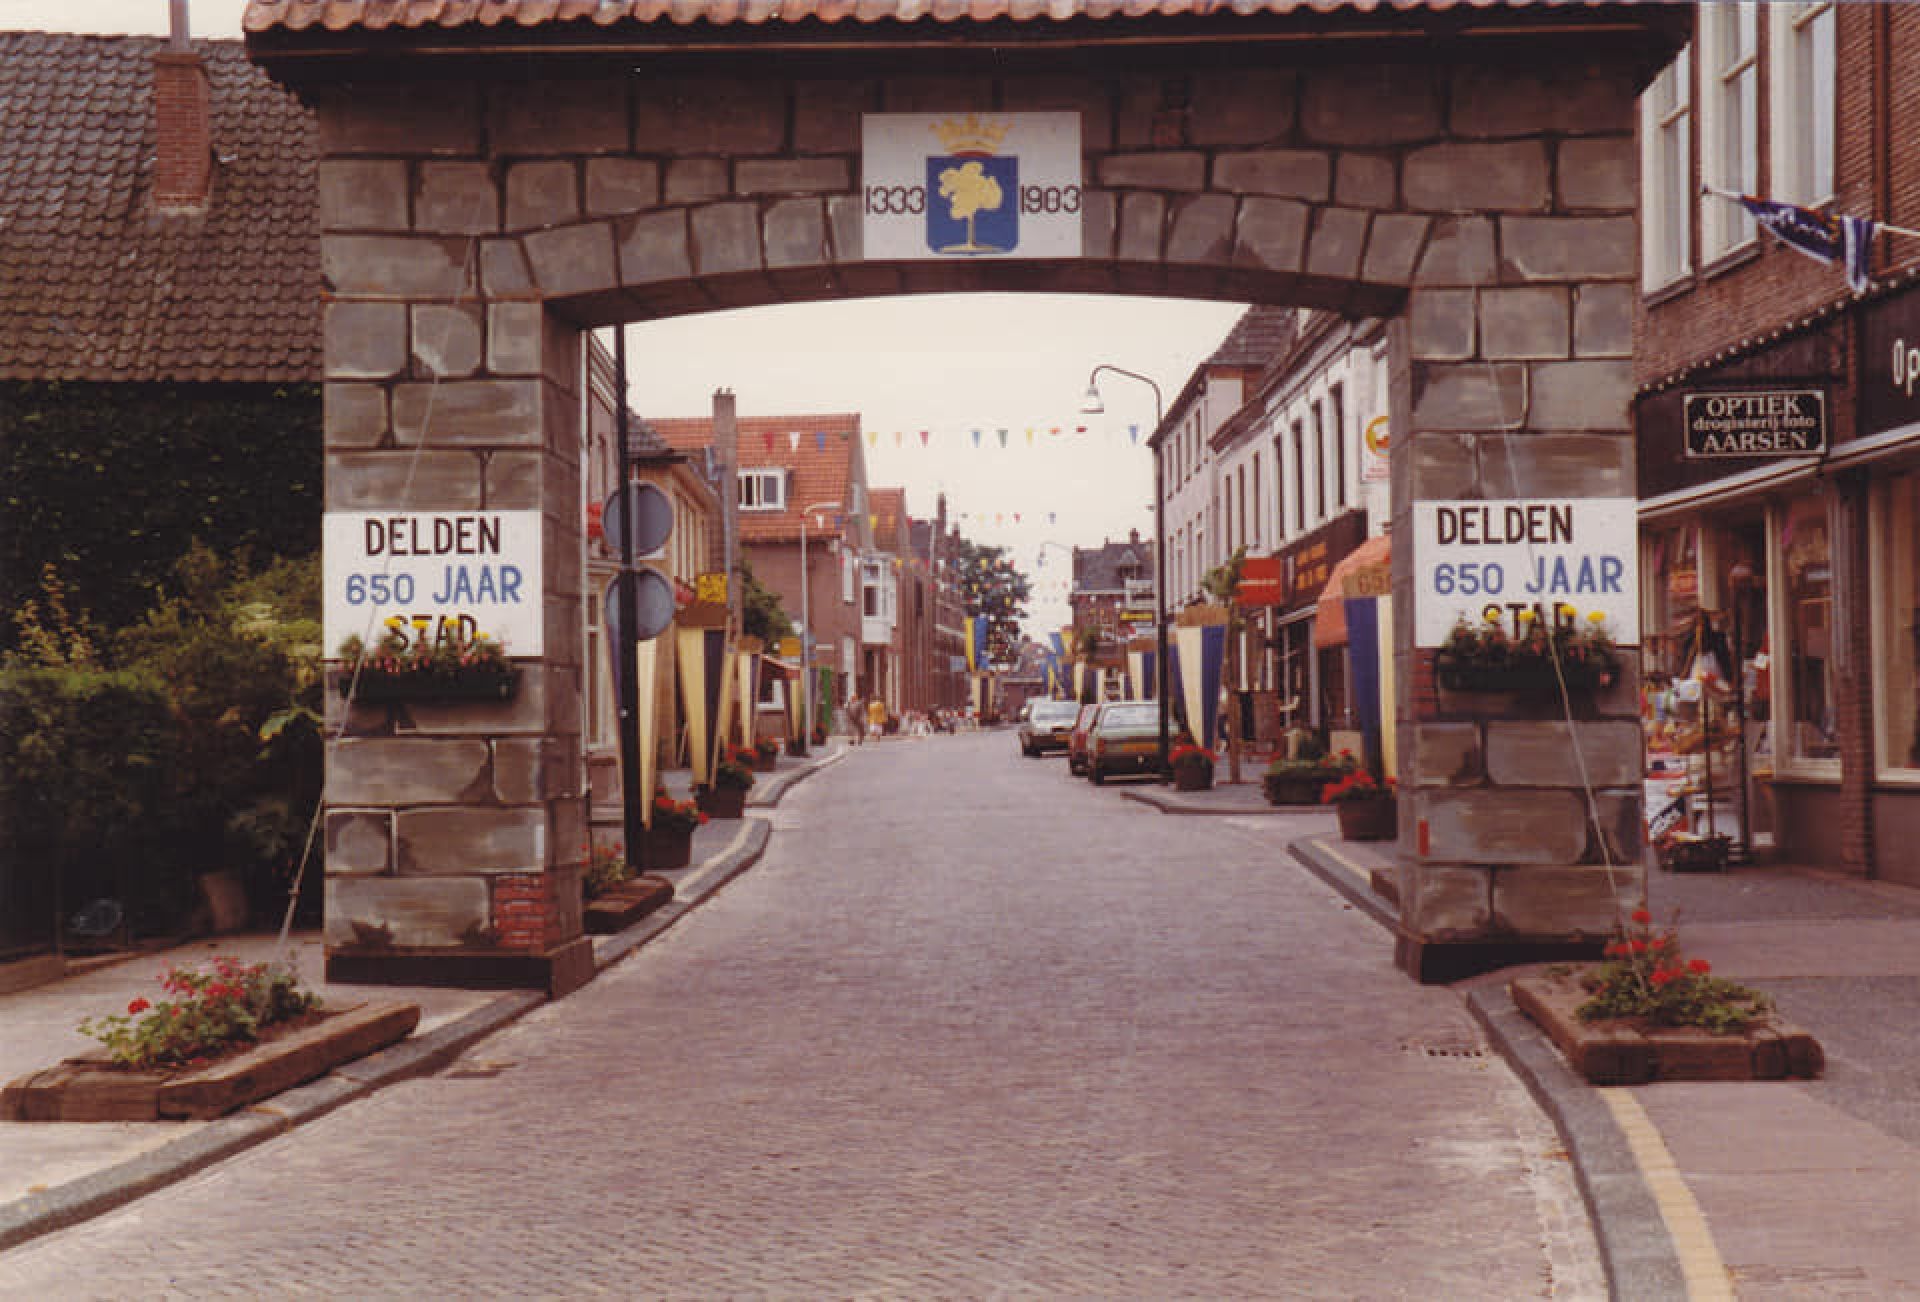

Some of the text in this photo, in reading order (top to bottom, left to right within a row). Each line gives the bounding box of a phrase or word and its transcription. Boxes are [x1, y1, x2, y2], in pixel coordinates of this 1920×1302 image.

[866, 185, 925, 215] 1333
[1706, 396, 1801, 417] OPTIEK
[1703, 432, 1807, 452] AARSEN
[365, 516, 500, 556] DELDEN
[1436, 505, 1573, 544] DELDEN
[346, 564, 523, 605] 650 JAAR
[1434, 555, 1624, 595] 650 JAAR
